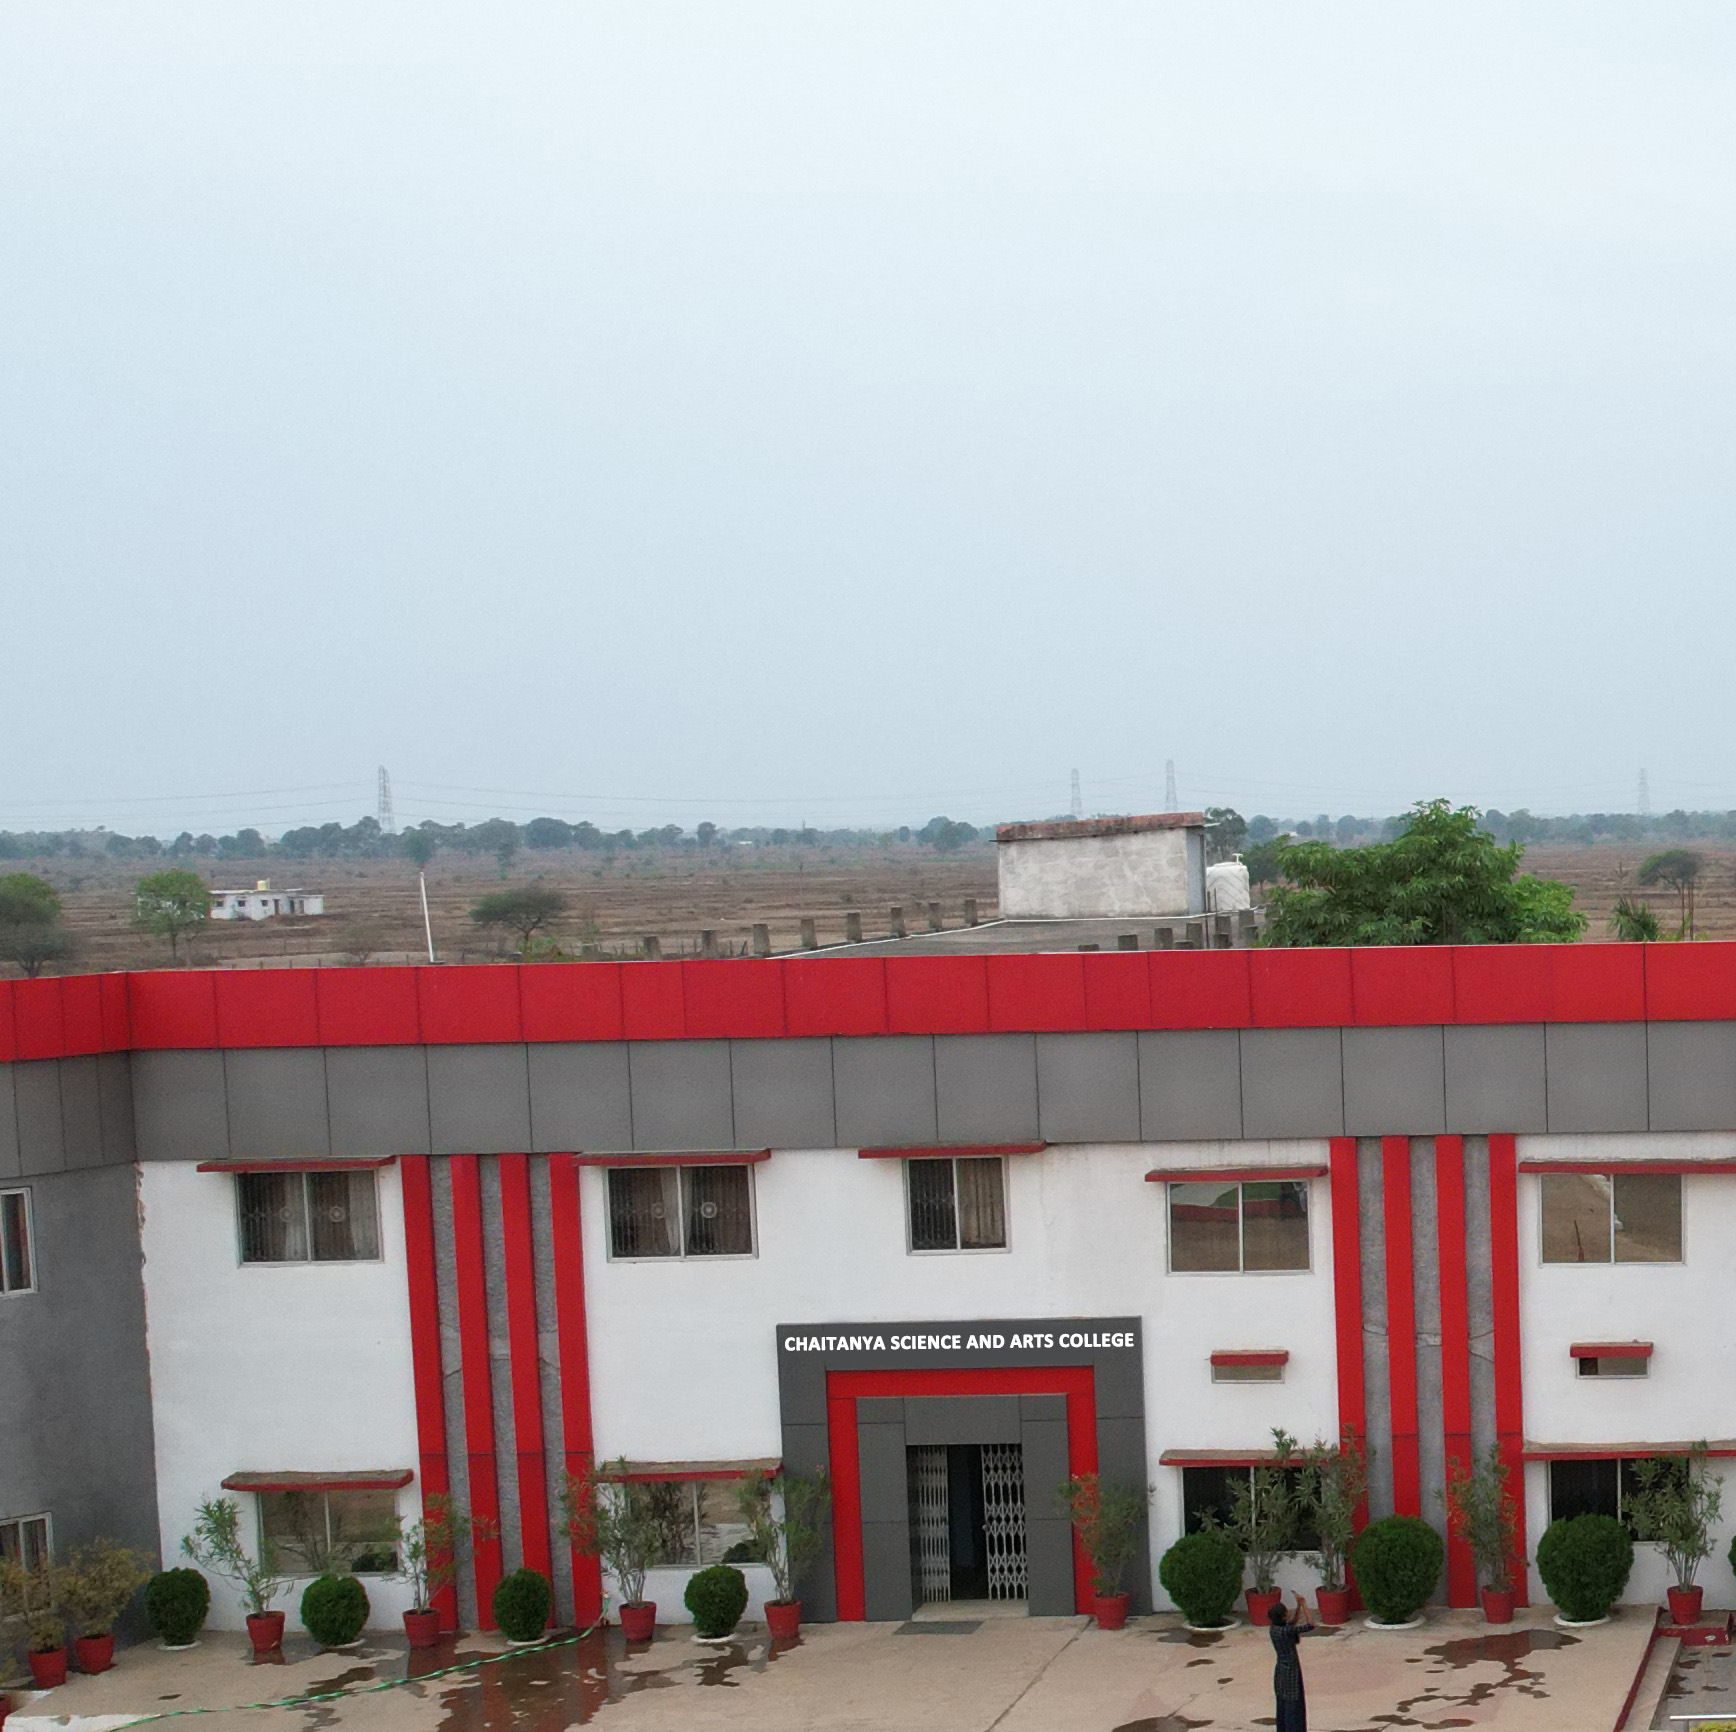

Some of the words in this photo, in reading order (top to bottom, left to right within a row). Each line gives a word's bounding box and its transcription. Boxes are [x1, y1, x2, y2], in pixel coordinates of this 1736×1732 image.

[785, 1336, 886, 1352] CHAITANYA
[890, 1335, 961, 1350] SCIENCE
[965, 1334, 1004, 1349] AND
[1009, 1333, 1053, 1348] ARTS
[1059, 1333, 1134, 1348] COLLEGE
